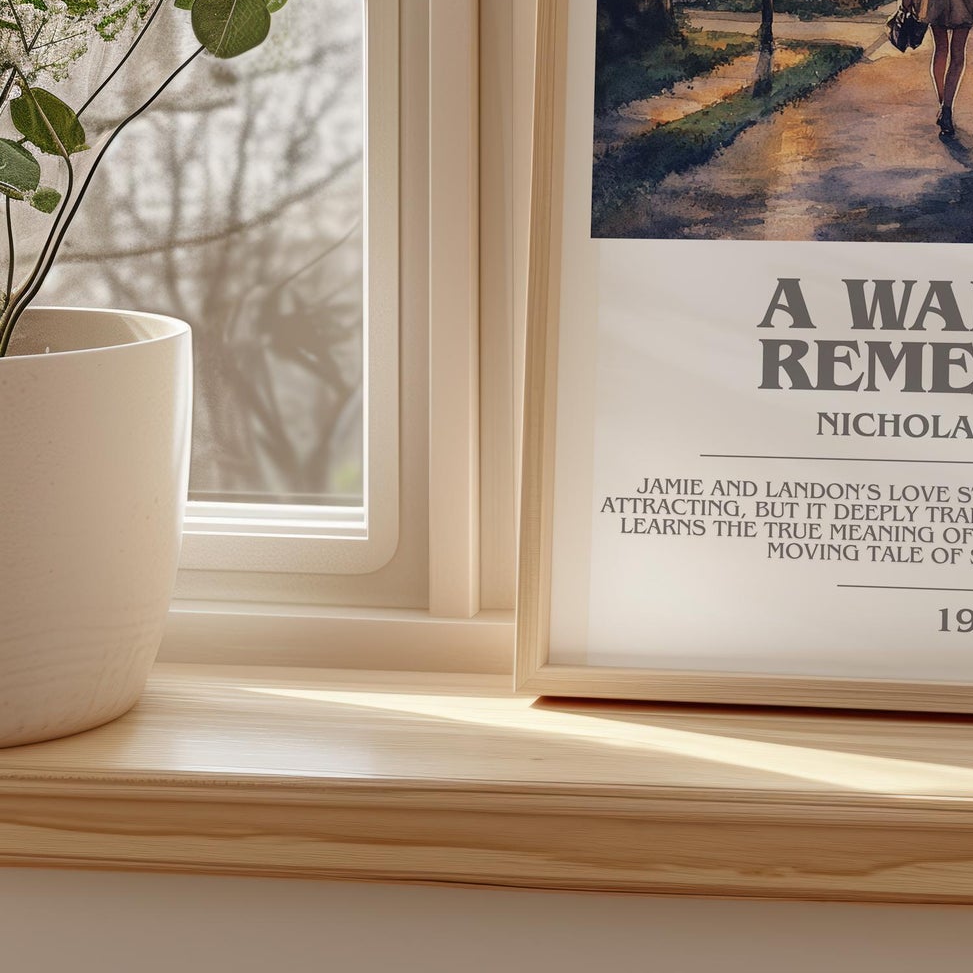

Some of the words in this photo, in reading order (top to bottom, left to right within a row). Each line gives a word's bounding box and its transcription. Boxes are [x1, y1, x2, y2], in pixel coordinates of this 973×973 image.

[757, 278, 817, 329] A
[637, 478, 704, 495] JAMIE
[710, 480, 758, 497] AND
[765, 481, 881, 500] LANDON'S
[889, 485, 950, 502] LOVE
[600, 497, 746, 519] ATTRACTING,
[755, 501, 799, 518] BUT
[806, 503, 827, 519] IT
[834, 504, 919, 522] DEEPLY
[621, 517, 706, 536] LEARNS
[712, 520, 758, 537] THE
[763, 522, 822, 539] TRUE
[830, 524, 934, 543] MEANING
[768, 542, 859, 561] MOVING
[866, 545, 924, 563] TALE
[931, 547, 963, 564] OF
